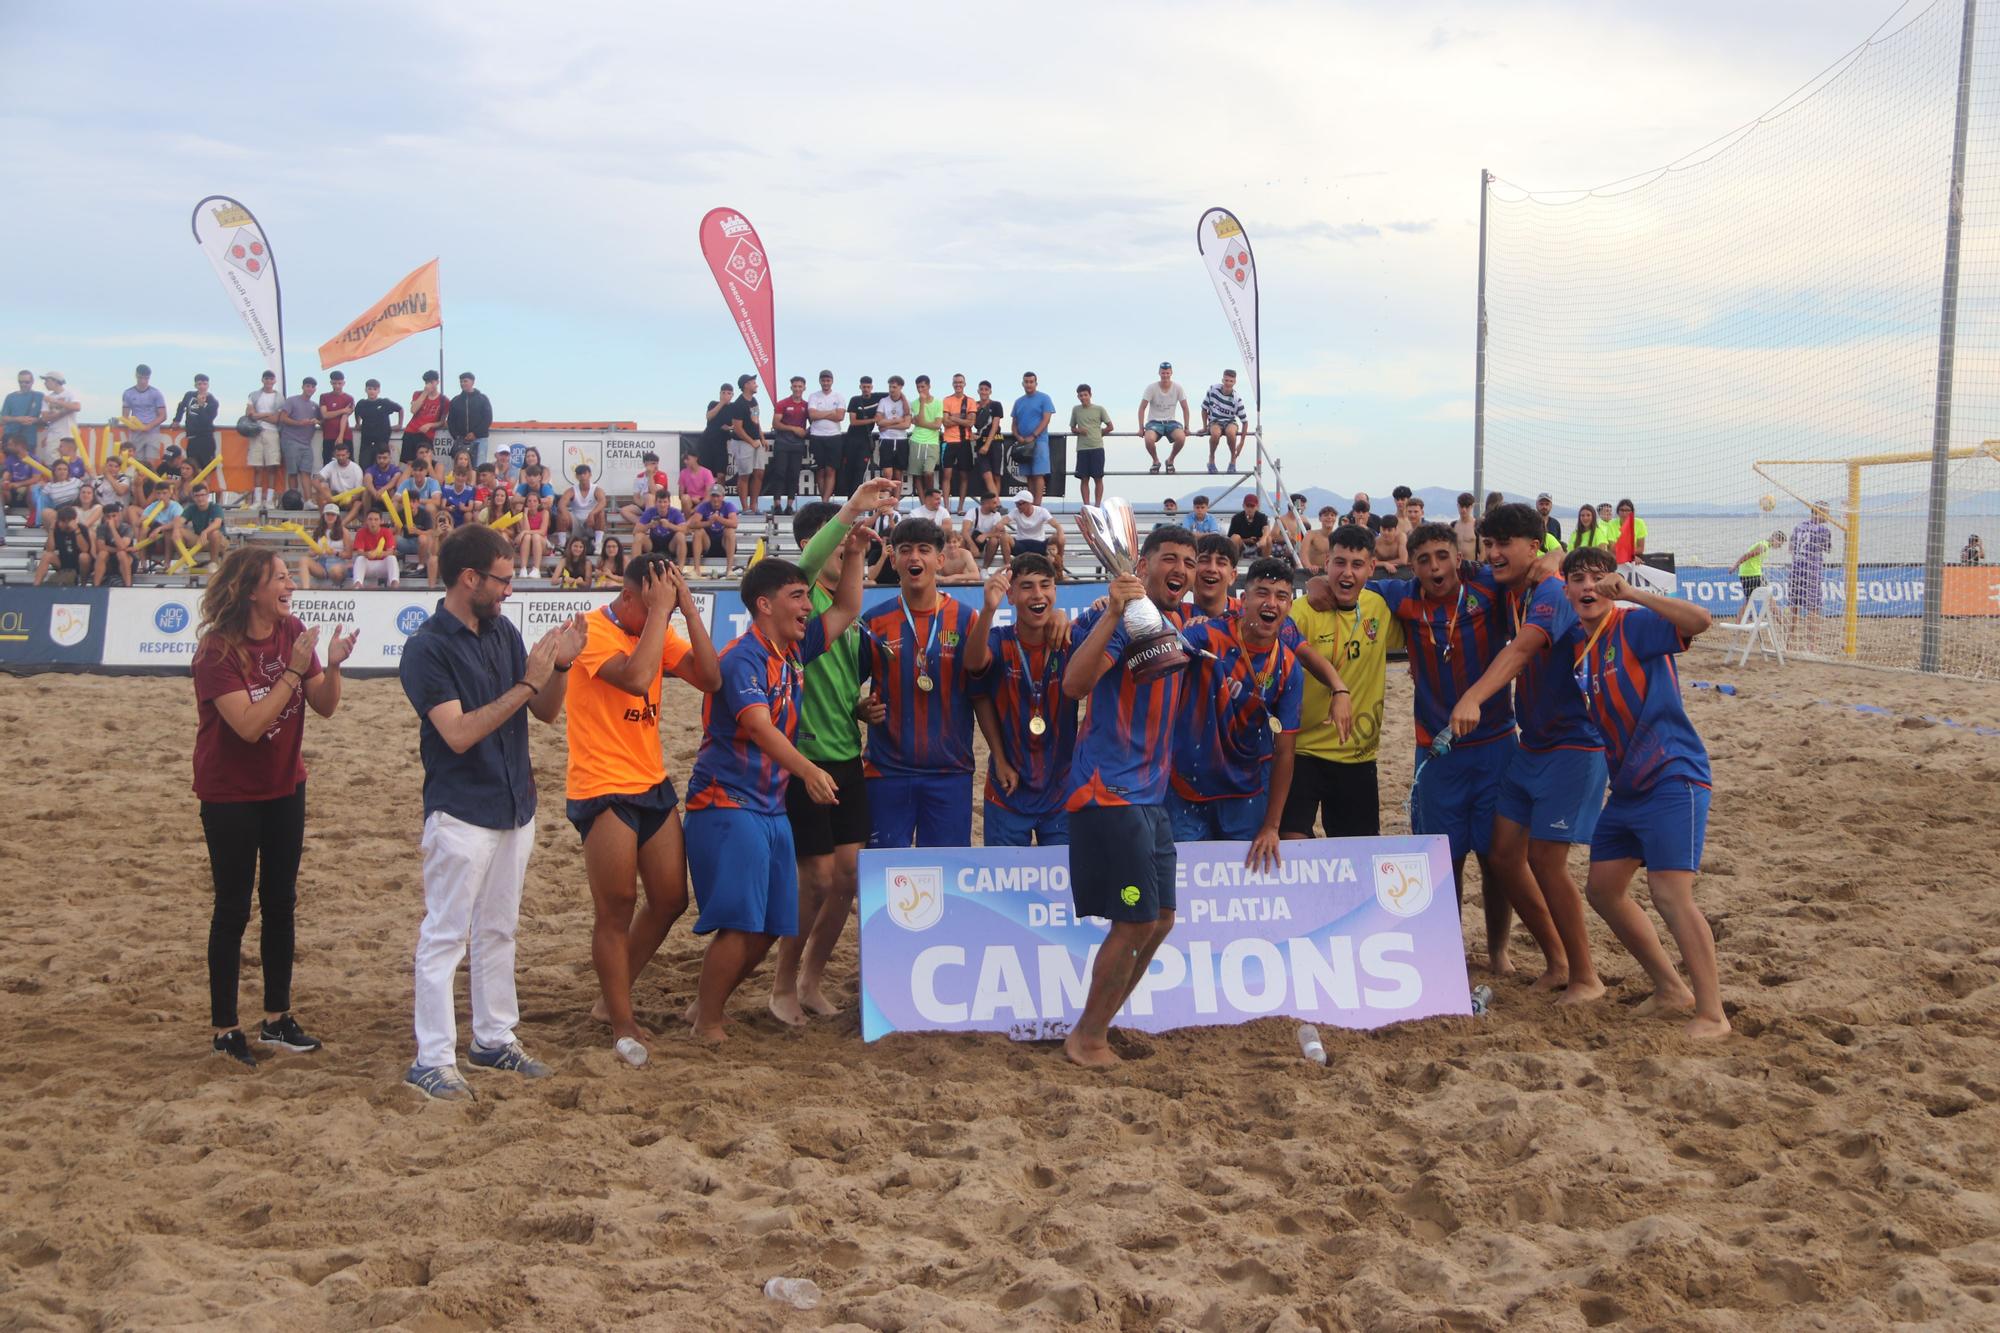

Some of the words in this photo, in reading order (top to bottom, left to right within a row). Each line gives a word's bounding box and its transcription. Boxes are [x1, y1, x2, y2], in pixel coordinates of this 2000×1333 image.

[606, 440, 656, 449] FEDERACIÓ
[1682, 581, 1744, 601] TOTS
[291, 599, 356, 610] FEDERACIÓ
[529, 600, 592, 611] FEDERACIÓ
[160, 607, 184, 619] JOC
[402, 611, 424, 620] JOC
[159, 618, 183, 627] NET
[1344, 640, 1360, 660] 13
[1193, 857, 1358, 887] CATALUNYA
[1028, 903, 1067, 927] DE
[1190, 896, 1293, 923] PLATJA
[911, 932, 1423, 1024] CAMPIONS
